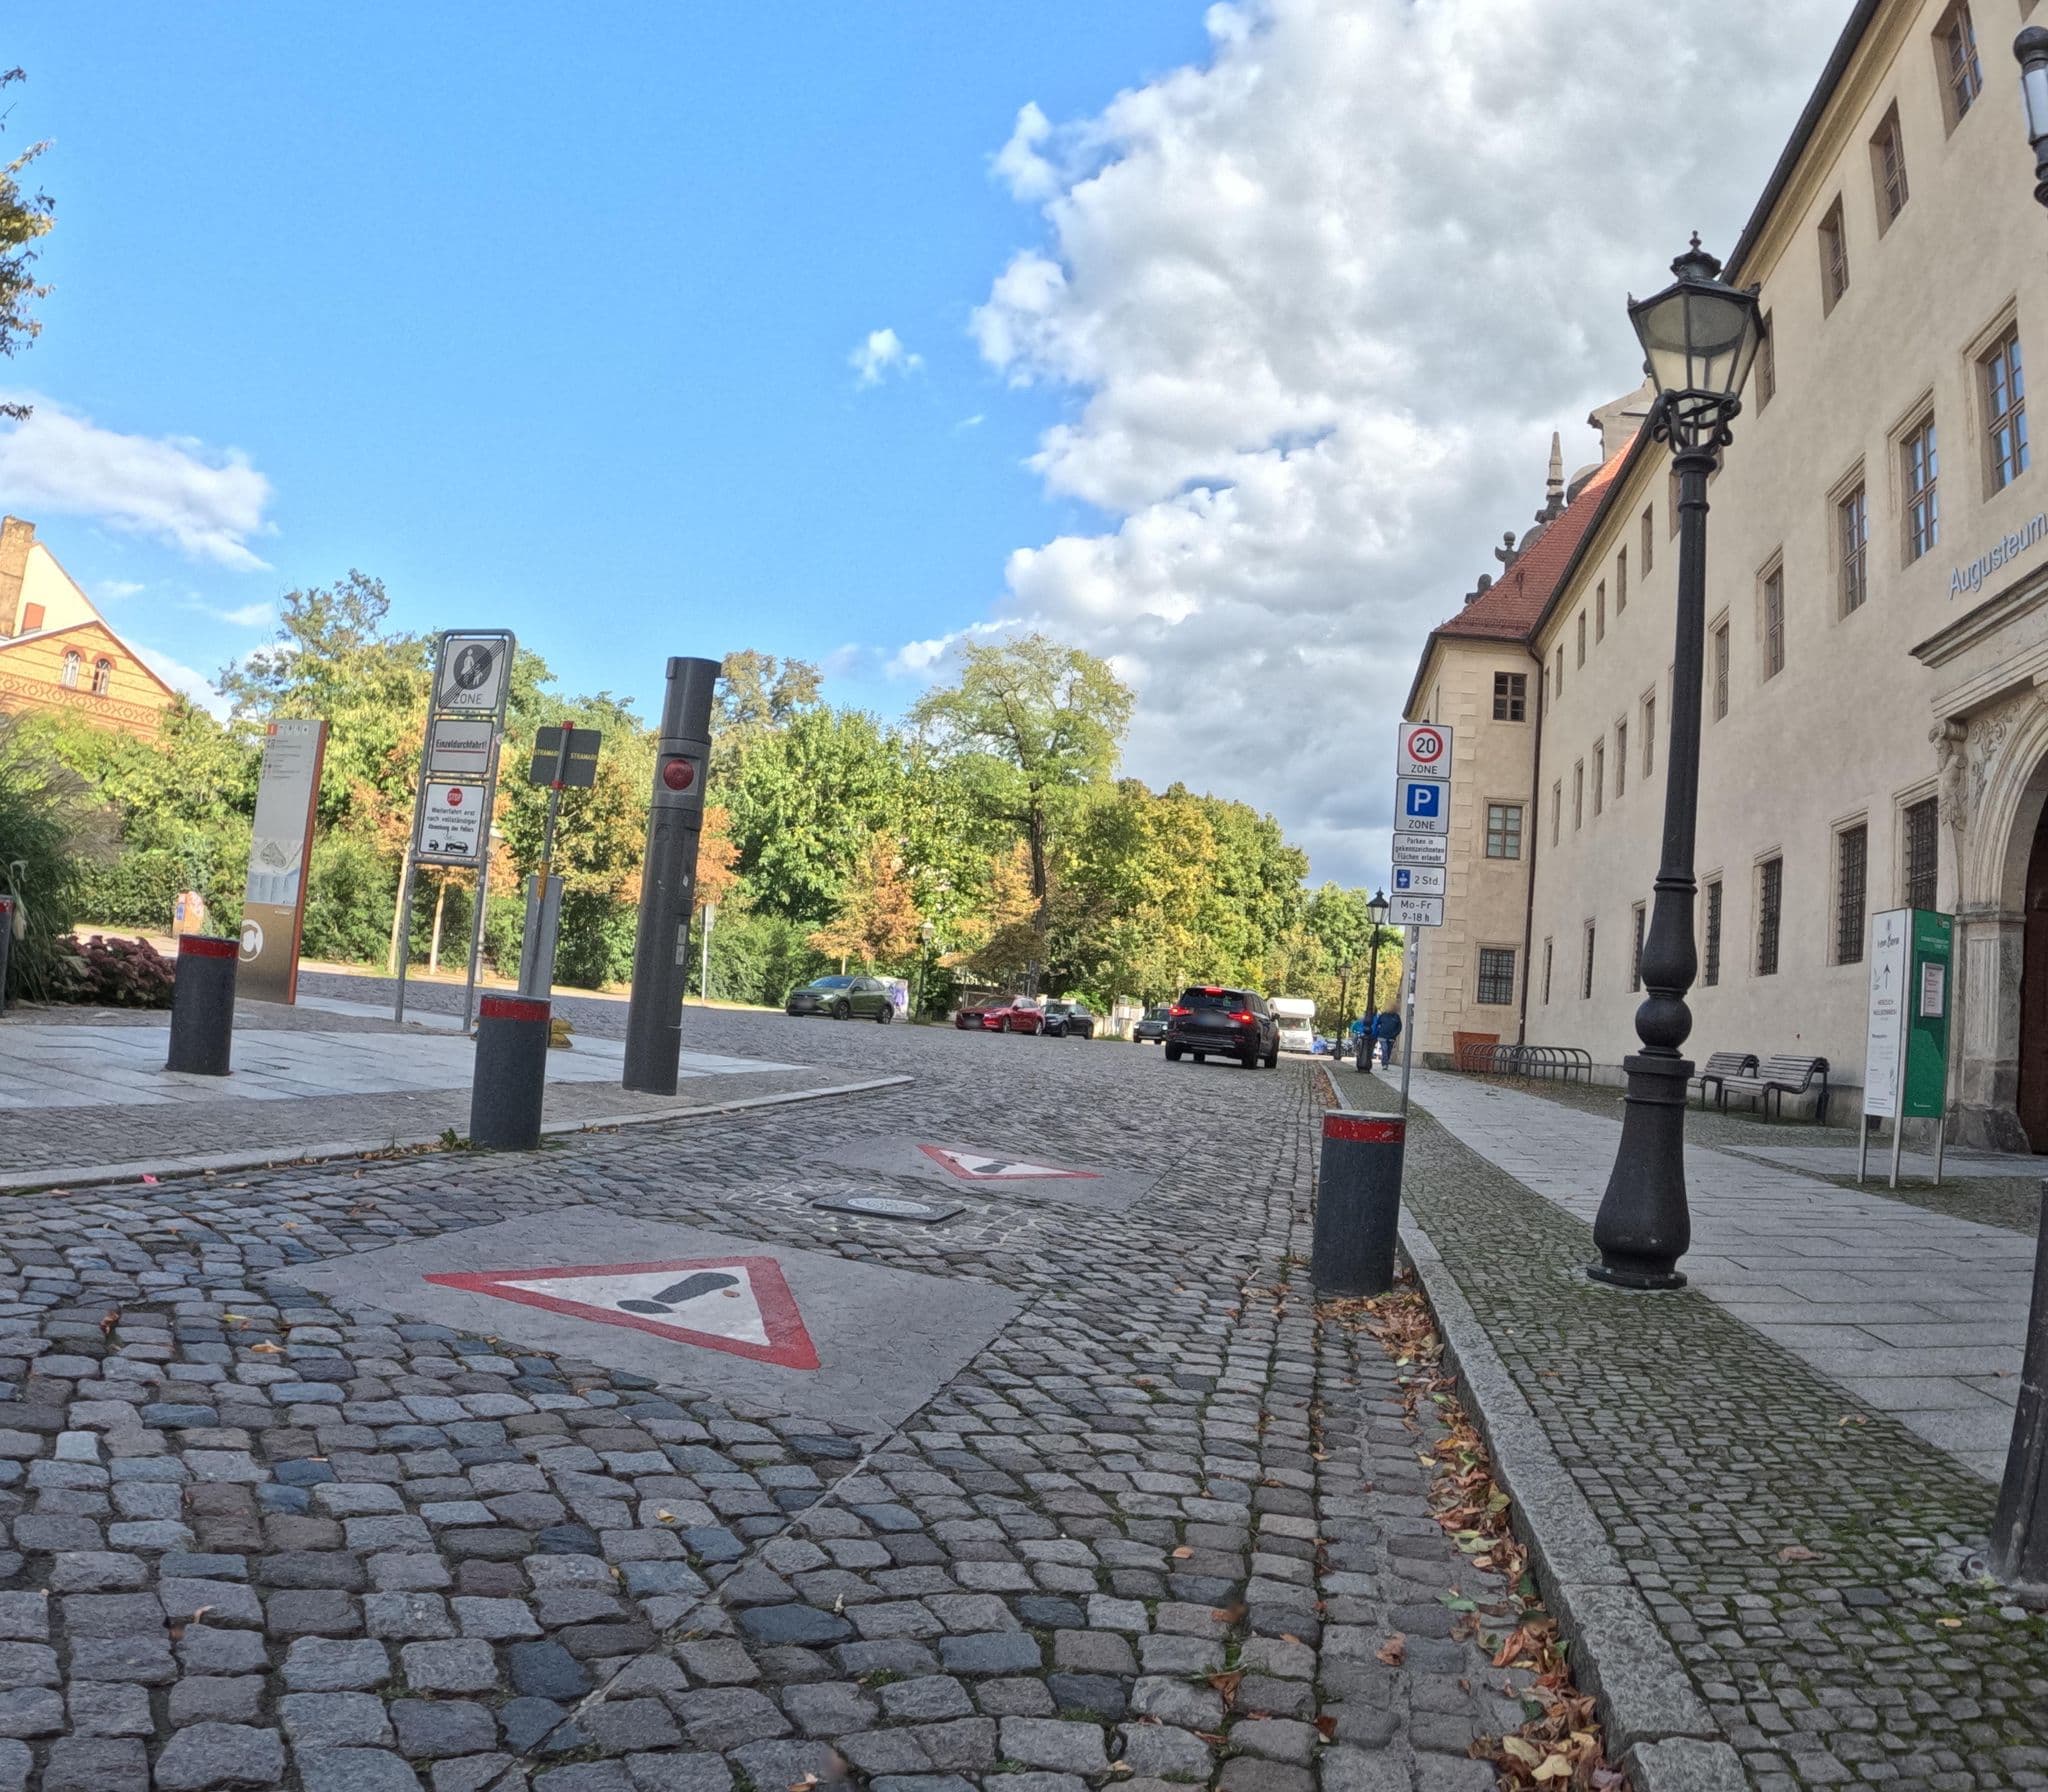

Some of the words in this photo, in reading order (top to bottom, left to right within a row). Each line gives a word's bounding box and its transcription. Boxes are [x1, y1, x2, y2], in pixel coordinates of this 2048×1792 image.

[1948, 512, 2048, 600] Augusteum
[1416, 737, 1436, 754] 20
[1411, 764, 1438, 775] ZONE
[1414, 788, 1432, 812] P
[1408, 819, 1435, 830] ZONE
[1406, 836, 1426, 844] Parken
[1414, 876, 1420, 885] 2
[1422, 876, 1440, 886] Std.
[1400, 900, 1432, 910] Mo-Fr
[1401, 912, 1423, 922] 9-18
[1424, 914, 1430, 923] h
